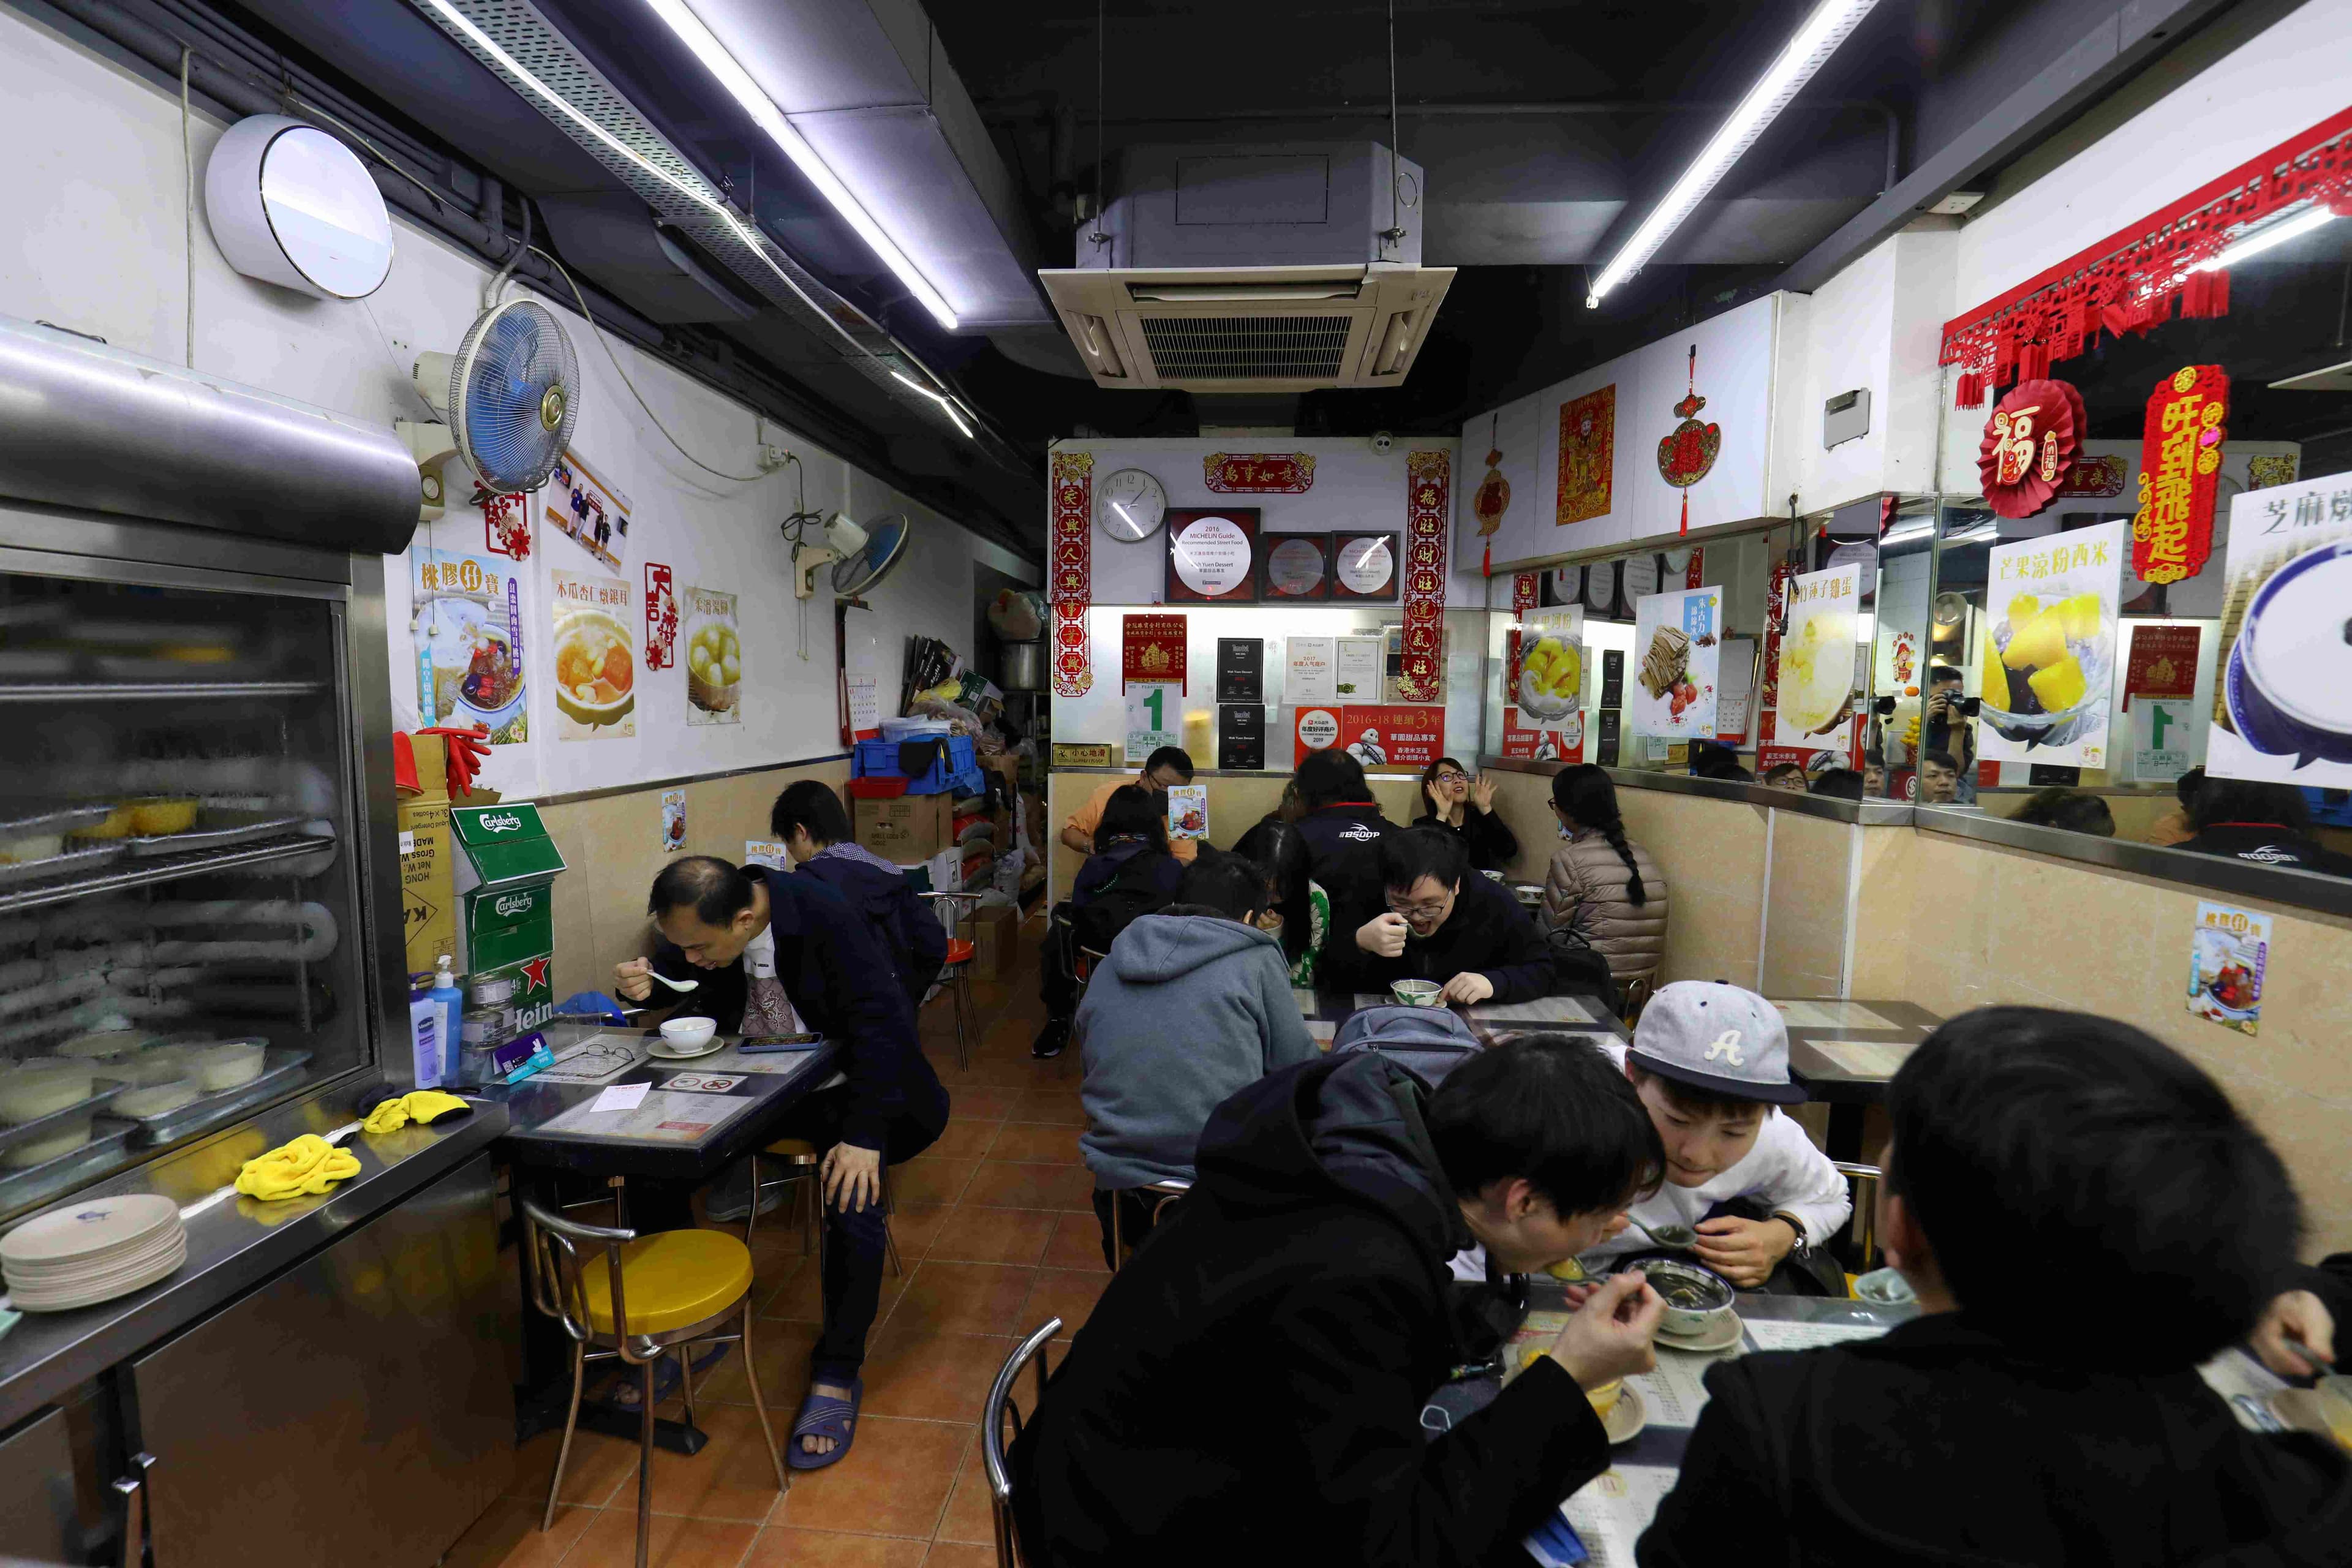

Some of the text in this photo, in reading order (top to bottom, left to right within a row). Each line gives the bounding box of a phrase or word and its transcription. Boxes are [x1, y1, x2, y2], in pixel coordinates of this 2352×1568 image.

[1992, 405, 2041, 483] 福
[1128, 475, 1134, 484] 12
[1223, 464, 1297, 483] 萬事如意
[2147, 394, 2203, 564] 旺到飛起
[1116, 478, 1121, 487] 11
[1105, 488, 1113, 497] 10
[1152, 488, 1156, 497] 2
[1102, 501, 1108, 510] 9
[1104, 514, 1110, 524] 8
[1150, 514, 1155, 523] 4
[1116, 524, 1121, 533] 7
[2000, 540, 2109, 581] 芒果涼粉西米
[1061, 489, 1080, 671] 家興人興事業興
[1412, 489, 1437, 675] 福旺財旺運氣旺
[557, 579, 628, 606] 木瓜杏仁燉銀耳
[1697, 597, 1706, 633] 朱古力
[1144, 688, 1163, 731] 1
[1347, 714, 1389, 725] 2016-18
[1072, 748, 1106, 757] 小心地滑
[480, 813, 521, 833] Carlsberg
[412, 849, 435, 859] Gross
[418, 861, 431, 870] Net
[405, 872, 429, 884] HONG
[496, 892, 532, 917] Carlsberg
[1703, 1029, 1746, 1068] A
